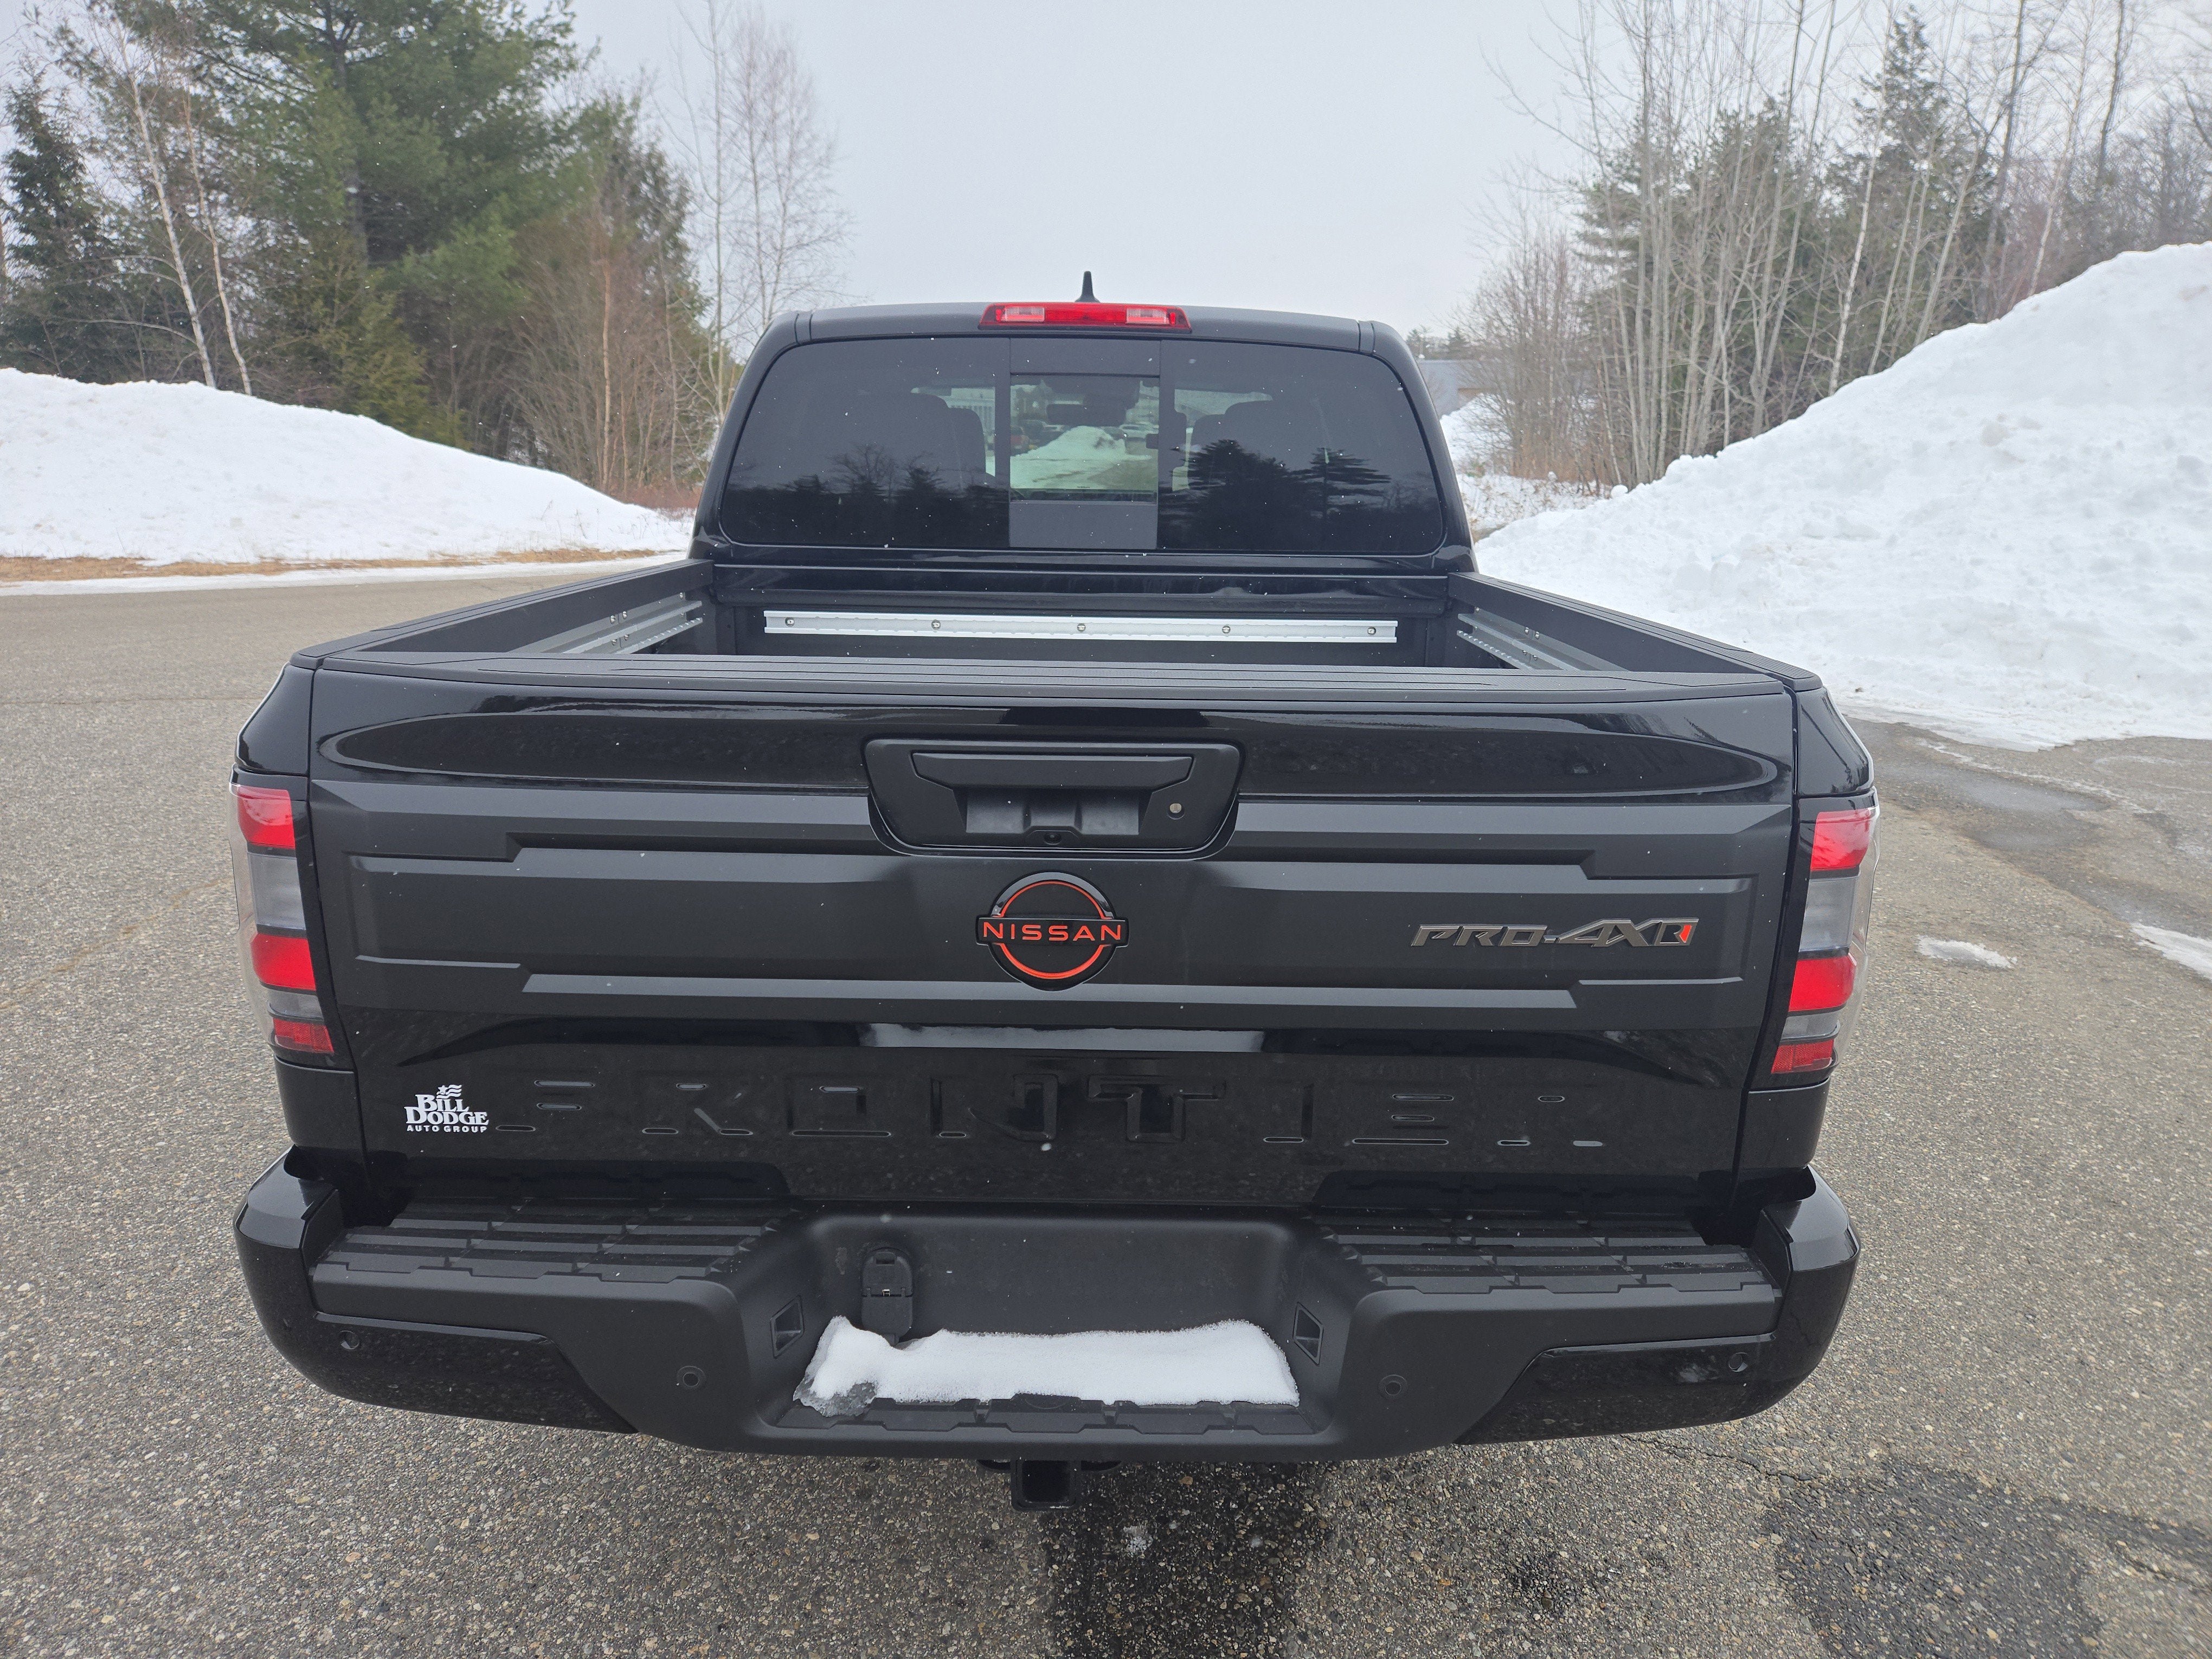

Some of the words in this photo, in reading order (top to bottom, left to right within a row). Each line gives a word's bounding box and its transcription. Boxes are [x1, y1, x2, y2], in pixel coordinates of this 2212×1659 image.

[983, 922, 1122, 941] NISSAN
[1411, 918, 1699, 947] PRO-4X
[415, 1094, 470, 1112] BILL
[404, 1106, 489, 1126] DODGE
